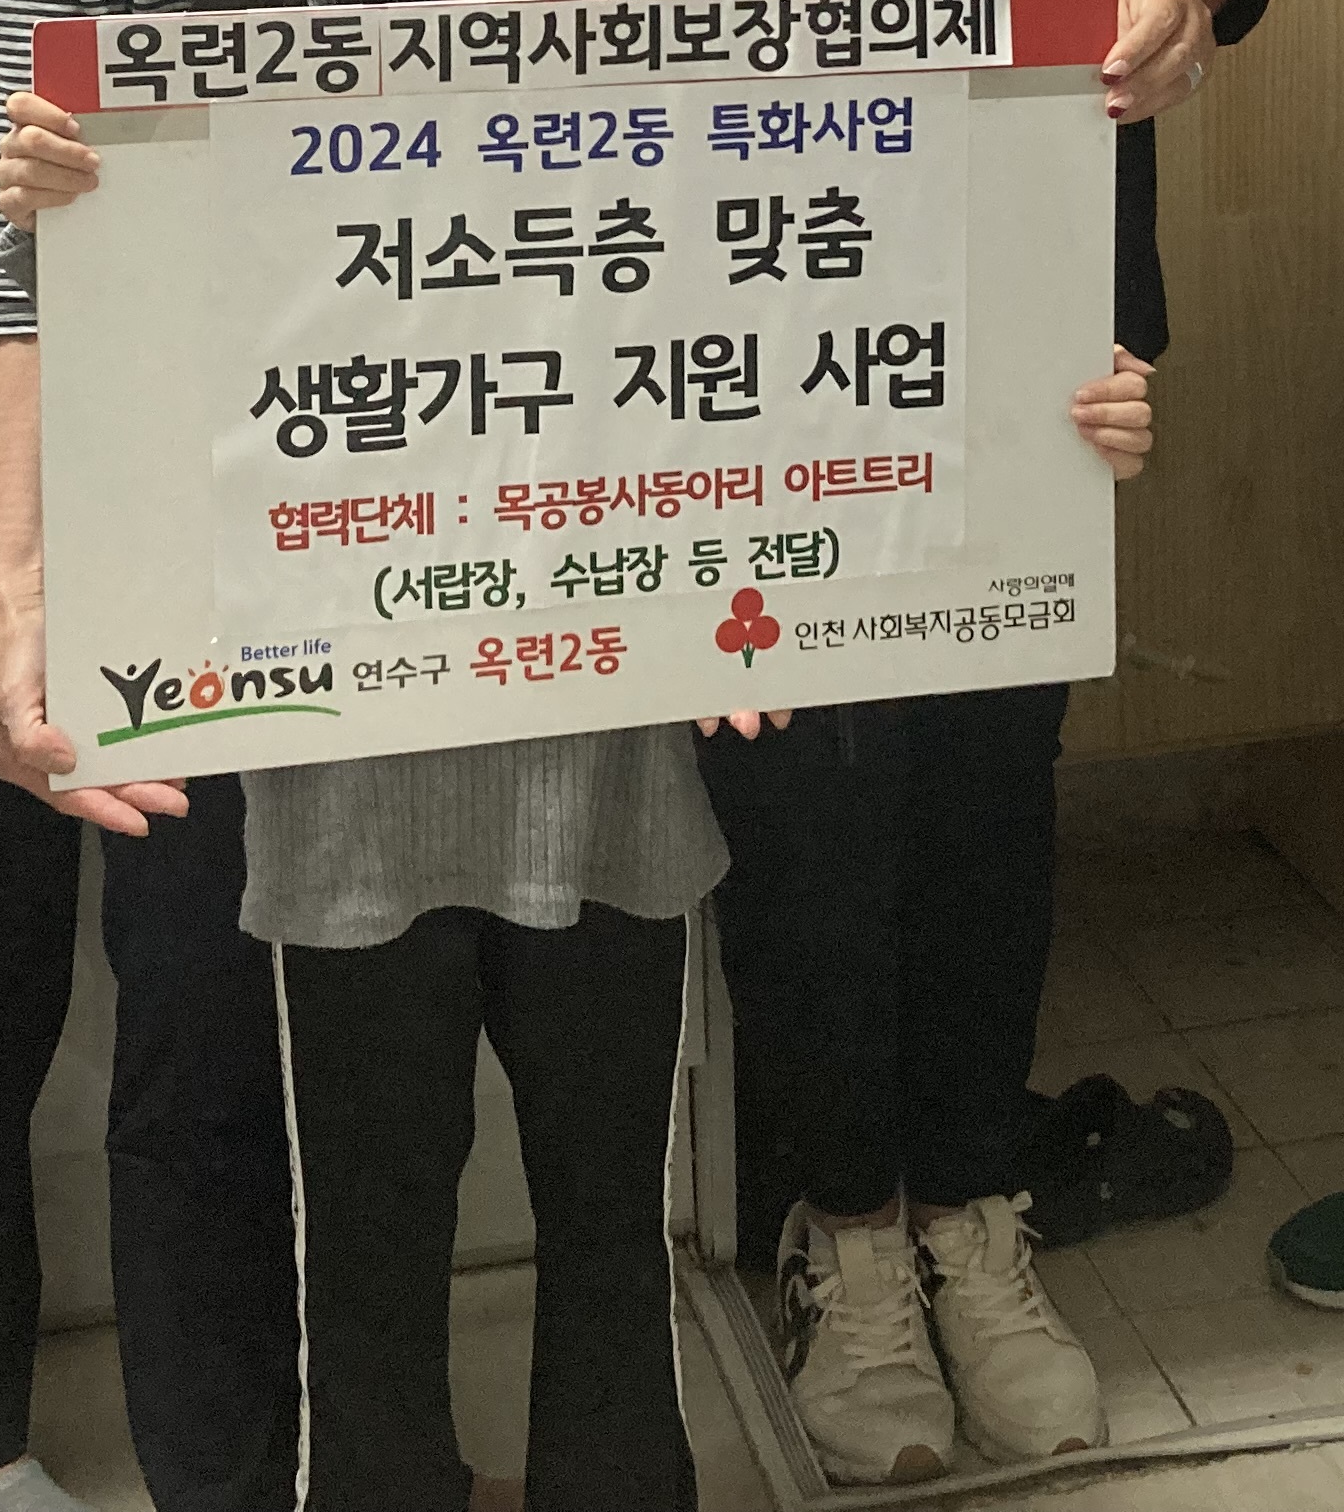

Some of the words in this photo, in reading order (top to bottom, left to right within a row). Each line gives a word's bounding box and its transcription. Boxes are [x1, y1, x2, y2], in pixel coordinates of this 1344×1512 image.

[105, 16, 372, 102] 옥련2동
[290, 120, 442, 176] 2024
[477, 106, 675, 173] 옥련2동
[707, 96, 913, 162] 특화사업
[335, 197, 664, 300] 저소득층
[716, 186, 873, 285] 맞춤
[250, 353, 574, 458] 생활가구
[612, 333, 761, 421] 지원
[800, 321, 945, 409] 사업
[268, 492, 435, 551] 협력단체
[493, 465, 764, 531] 목공봉사동아리
[783, 452, 933, 501] 아트트리
[373, 558, 526, 620] (서랍장,
[550, 543, 668, 600] 수납장
[688, 538, 729, 586] 등
[746, 526, 840, 580] 전달)
[988, 573, 1075, 597] 사랑의열매
[240, 643, 297, 662] Better
[303, 637, 332, 657] life
[352, 654, 452, 692] 연수구
[469, 625, 628, 686] 옥련2동
[794, 619, 845, 651] 인천
[852, 598, 1076, 644] 사회복지공동모금회
[99, 657, 334, 730] Yeonsu
